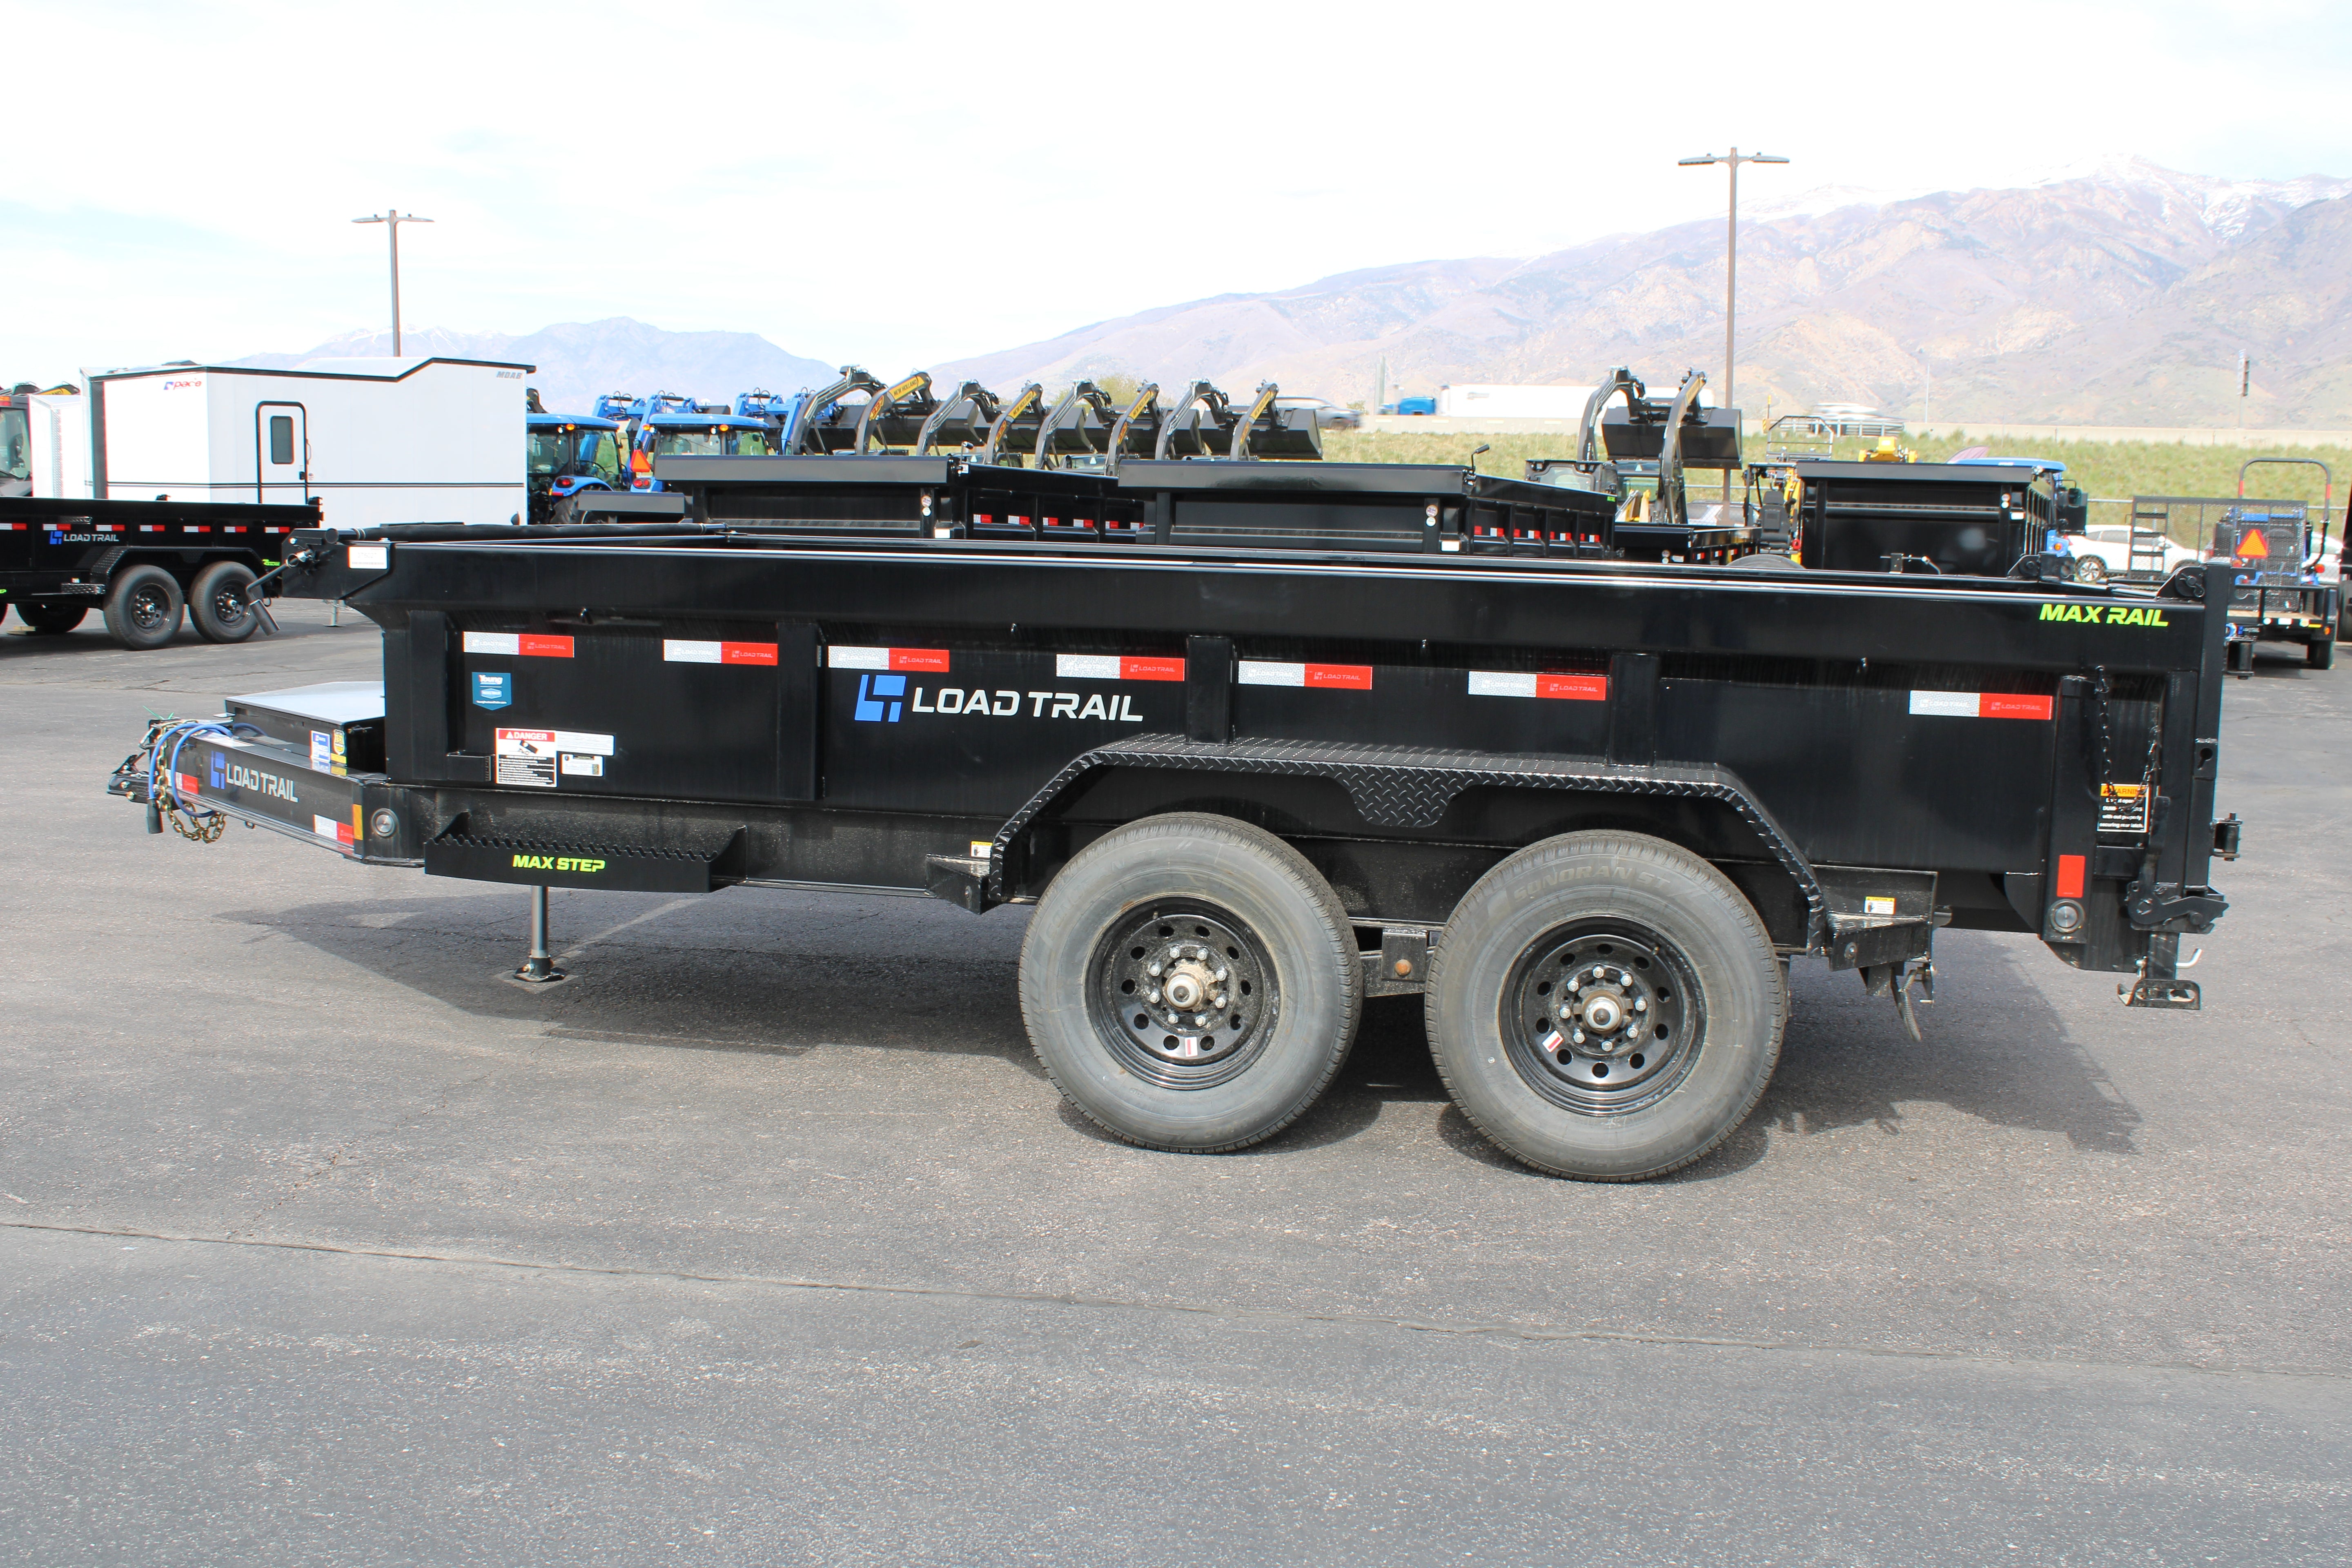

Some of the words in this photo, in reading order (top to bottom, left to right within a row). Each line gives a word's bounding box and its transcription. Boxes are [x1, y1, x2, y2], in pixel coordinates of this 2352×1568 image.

[893, 387, 902, 396] NEW
[901, 379, 917, 391] HOLLAND
[2039, 604, 2104, 624] MAX
[2106, 607, 2169, 627] RAIL
[478, 675, 503, 685] Young
[912, 687, 1020, 716] LOAD
[1028, 691, 1144, 722] TRAIL
[514, 732, 547, 740] DANGER
[225, 763, 260, 791] LOAD
[261, 772, 299, 803] TRAIL
[512, 855, 555, 870] MAX
[556, 857, 606, 873] STEP
[1133, 848, 1161, 864] ST
[1513, 866, 1633, 899] SONORAN
[1637, 871, 1670, 889] ST
